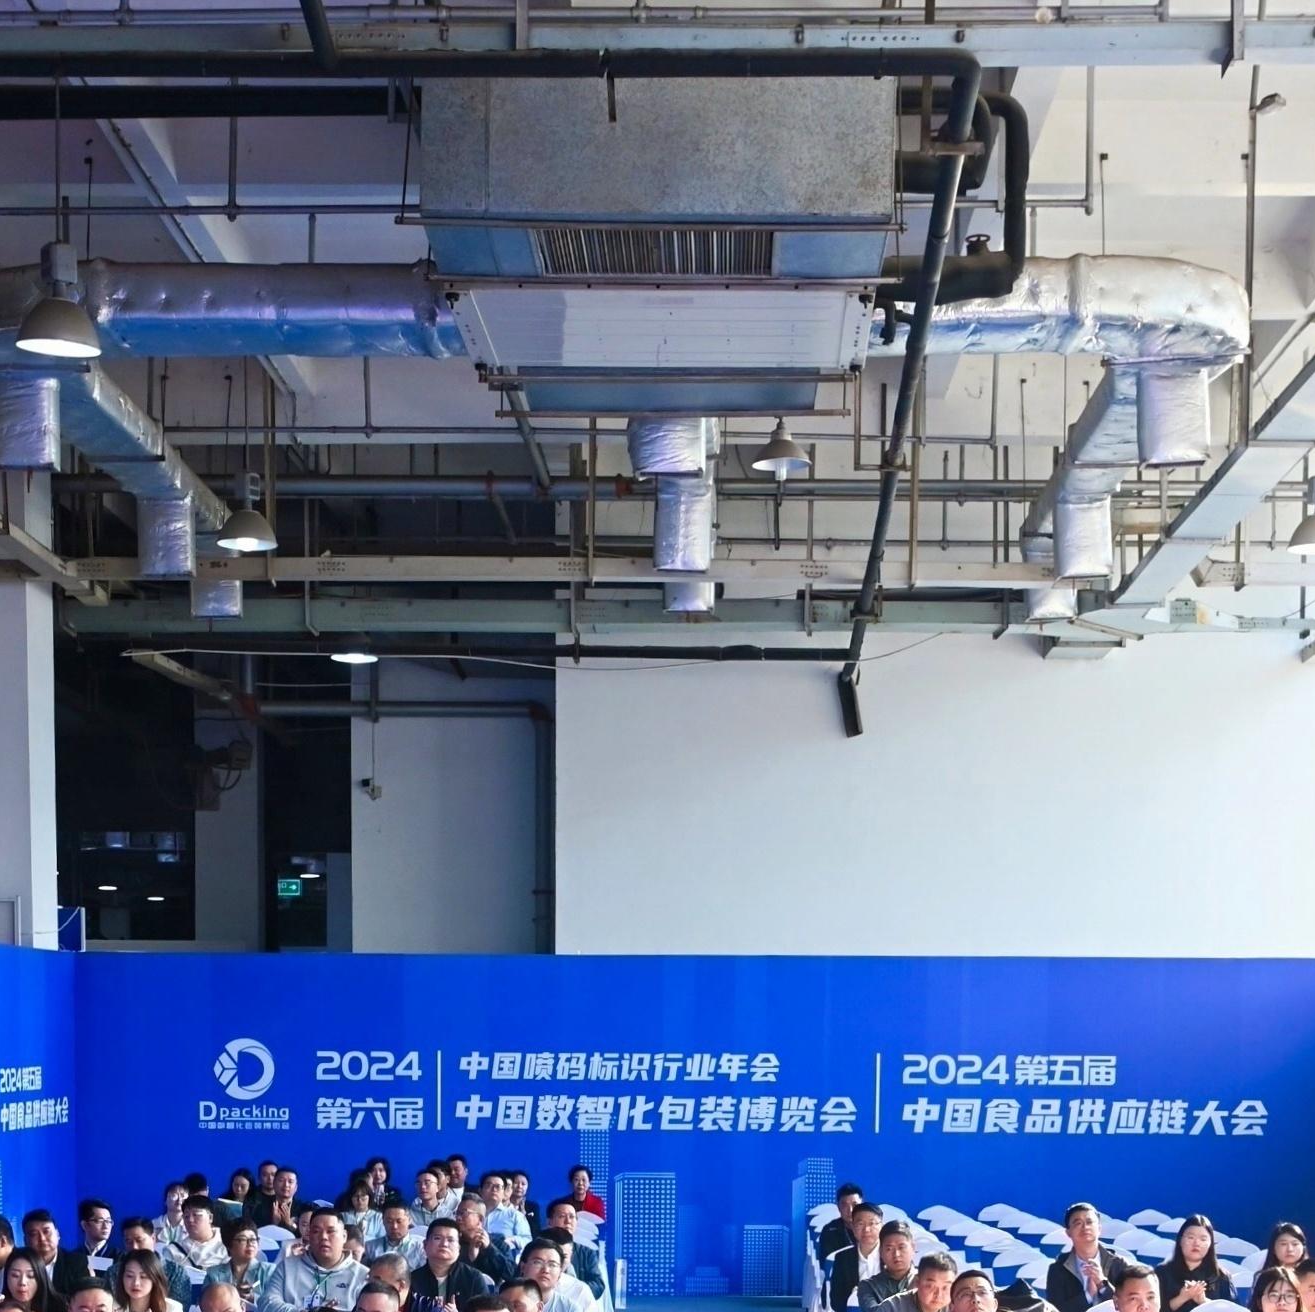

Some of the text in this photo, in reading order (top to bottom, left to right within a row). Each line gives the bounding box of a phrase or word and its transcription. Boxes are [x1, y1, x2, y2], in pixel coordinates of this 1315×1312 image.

[316, 1050, 423, 1081] 2024
[459, 1051, 780, 1082] 中国喷码标识行业年会
[0, 1096, 69, 1132] 中国食品供应链大会
[199, 1100, 290, 1121] Dpacking
[316, 1097, 424, 1130] 第六届
[455, 1094, 858, 1133] 中国数智化包装博览会
[901, 1097, 1269, 1137] 中国食品供应链大会
